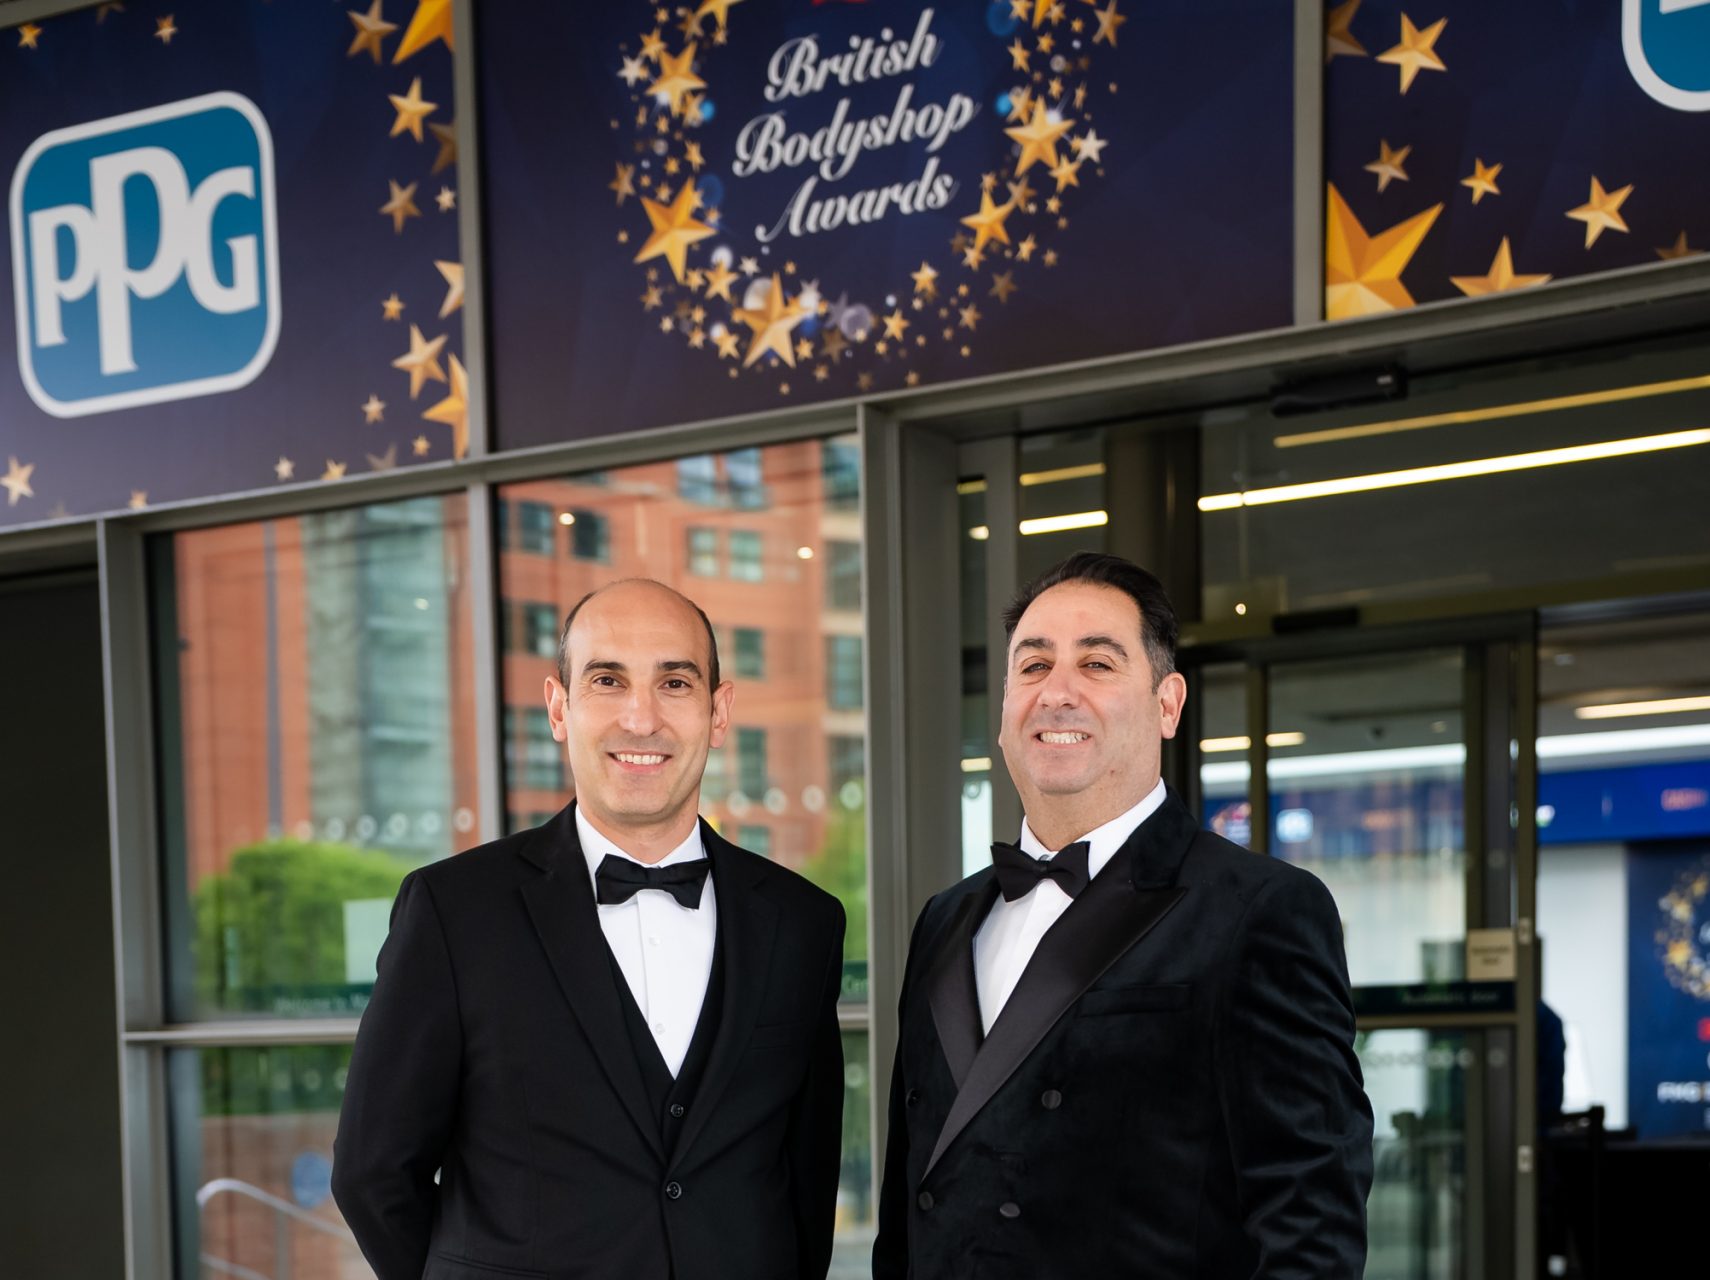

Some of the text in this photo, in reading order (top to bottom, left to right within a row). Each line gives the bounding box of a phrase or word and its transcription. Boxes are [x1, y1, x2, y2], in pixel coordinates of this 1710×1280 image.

[764, 8, 943, 102] British
[732, 84, 981, 181] Bodyshop
[755, 156, 960, 243] Awards
[29, 146, 260, 376] PPG
